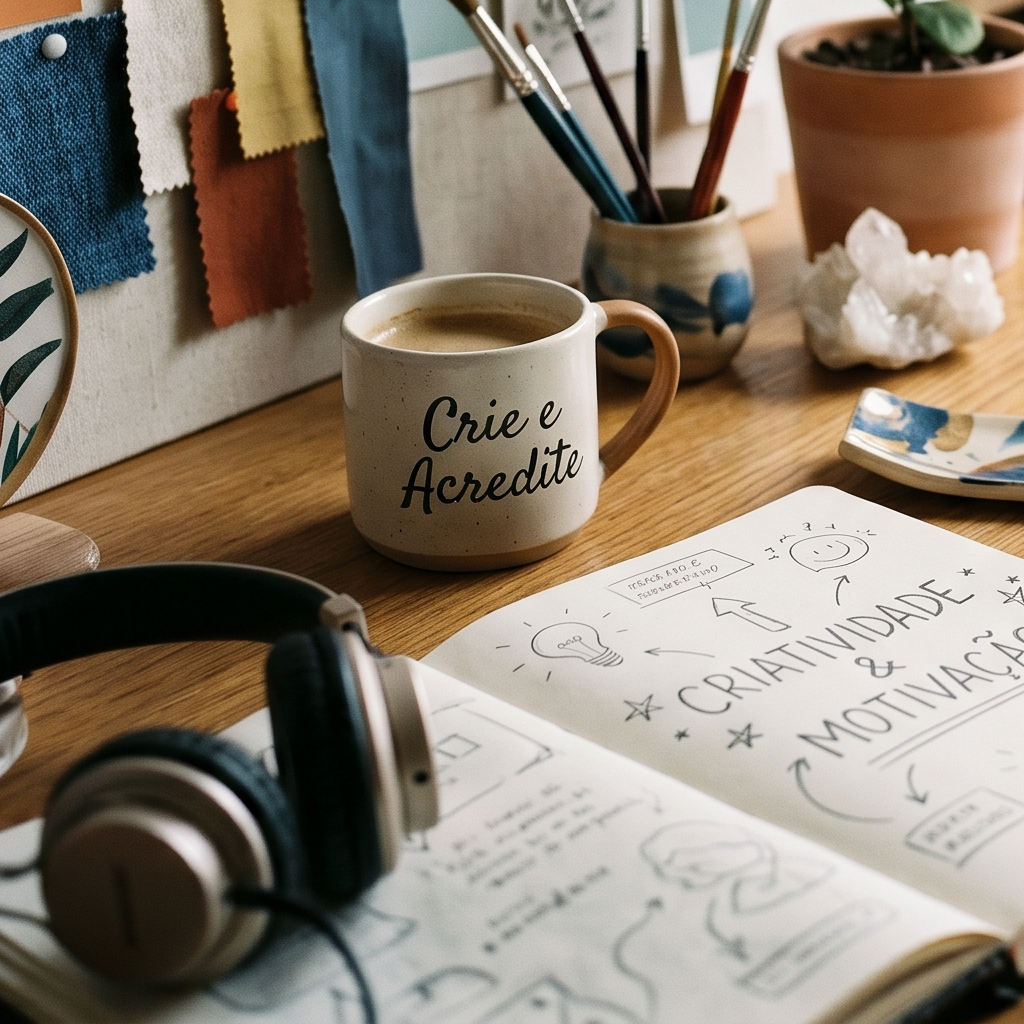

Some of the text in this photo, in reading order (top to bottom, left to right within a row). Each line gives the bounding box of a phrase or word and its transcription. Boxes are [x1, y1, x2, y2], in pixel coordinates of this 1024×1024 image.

[422, 395, 563, 453] Crie e
[400, 437, 584, 515] Acredite
[677, 578, 975, 715] CRIATIVIDADE
[854, 656, 907, 678] &
